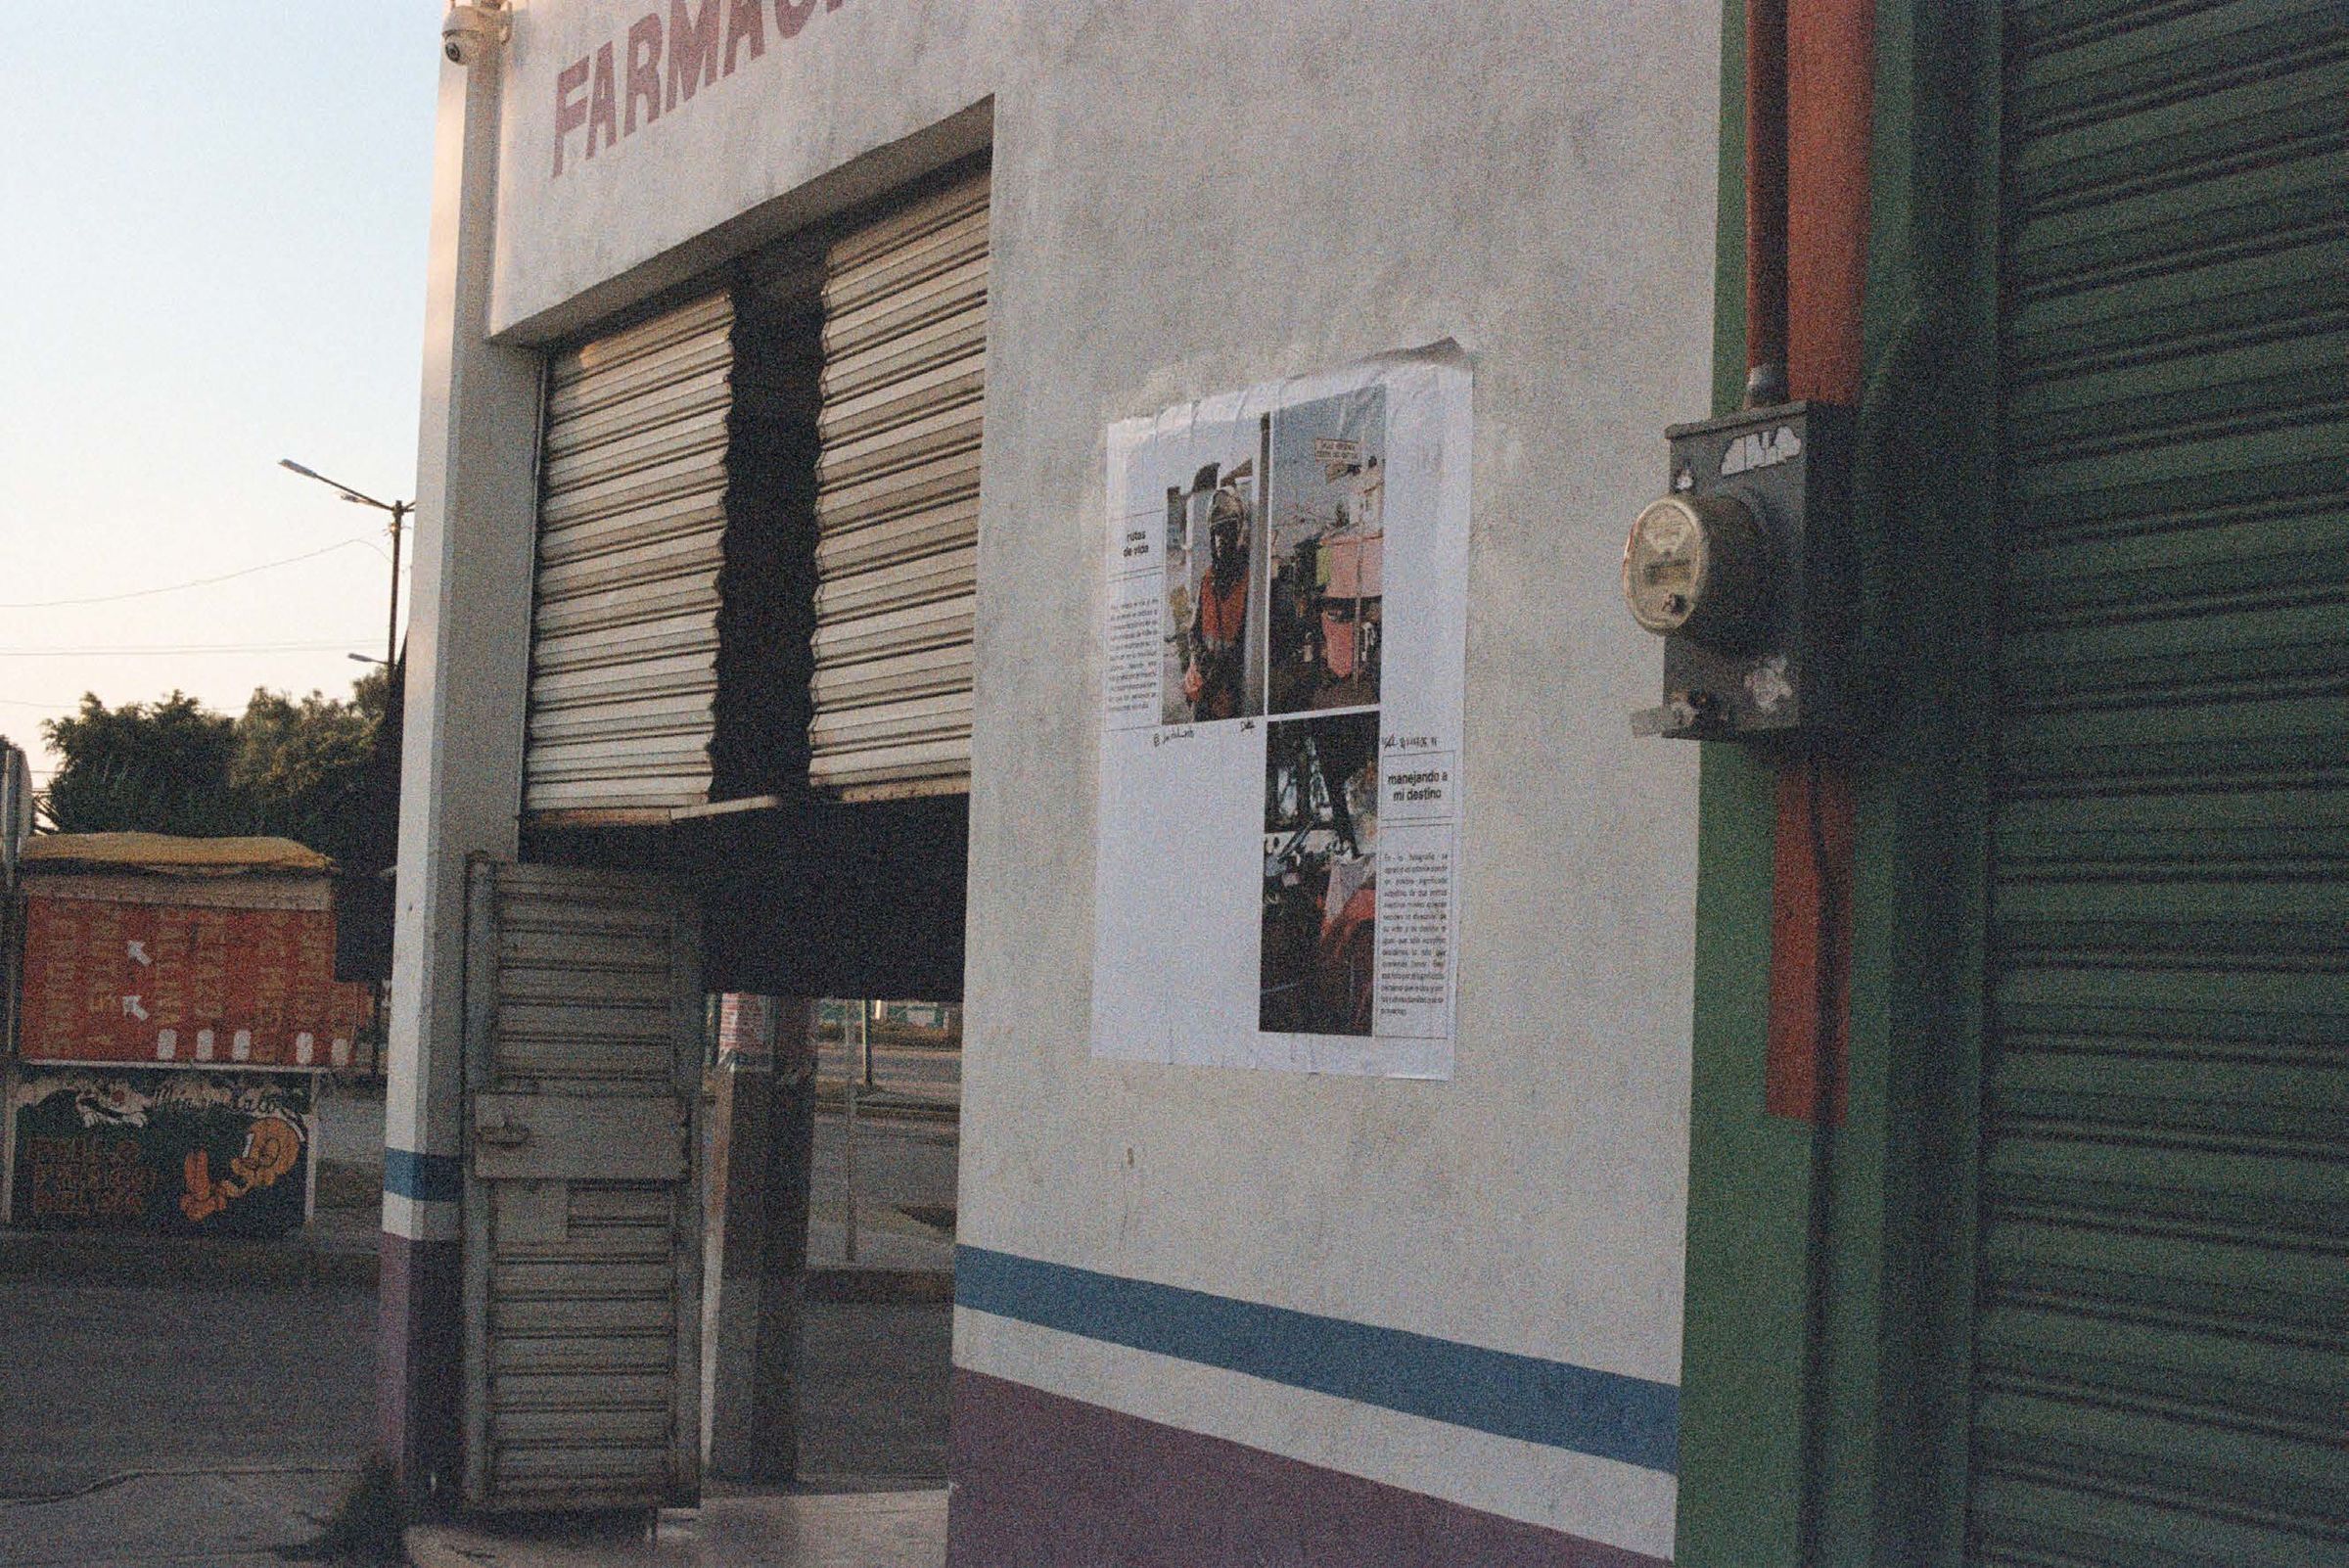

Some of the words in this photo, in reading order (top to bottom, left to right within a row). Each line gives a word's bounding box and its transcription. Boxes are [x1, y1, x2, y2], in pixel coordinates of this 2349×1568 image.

[551, 0, 843, 179] FARMA
[1387, 770, 1440, 786] manejando
[1442, 771, 1448, 782] a
[1393, 789, 1405, 802] mi
[1406, 786, 1442, 801] destino
